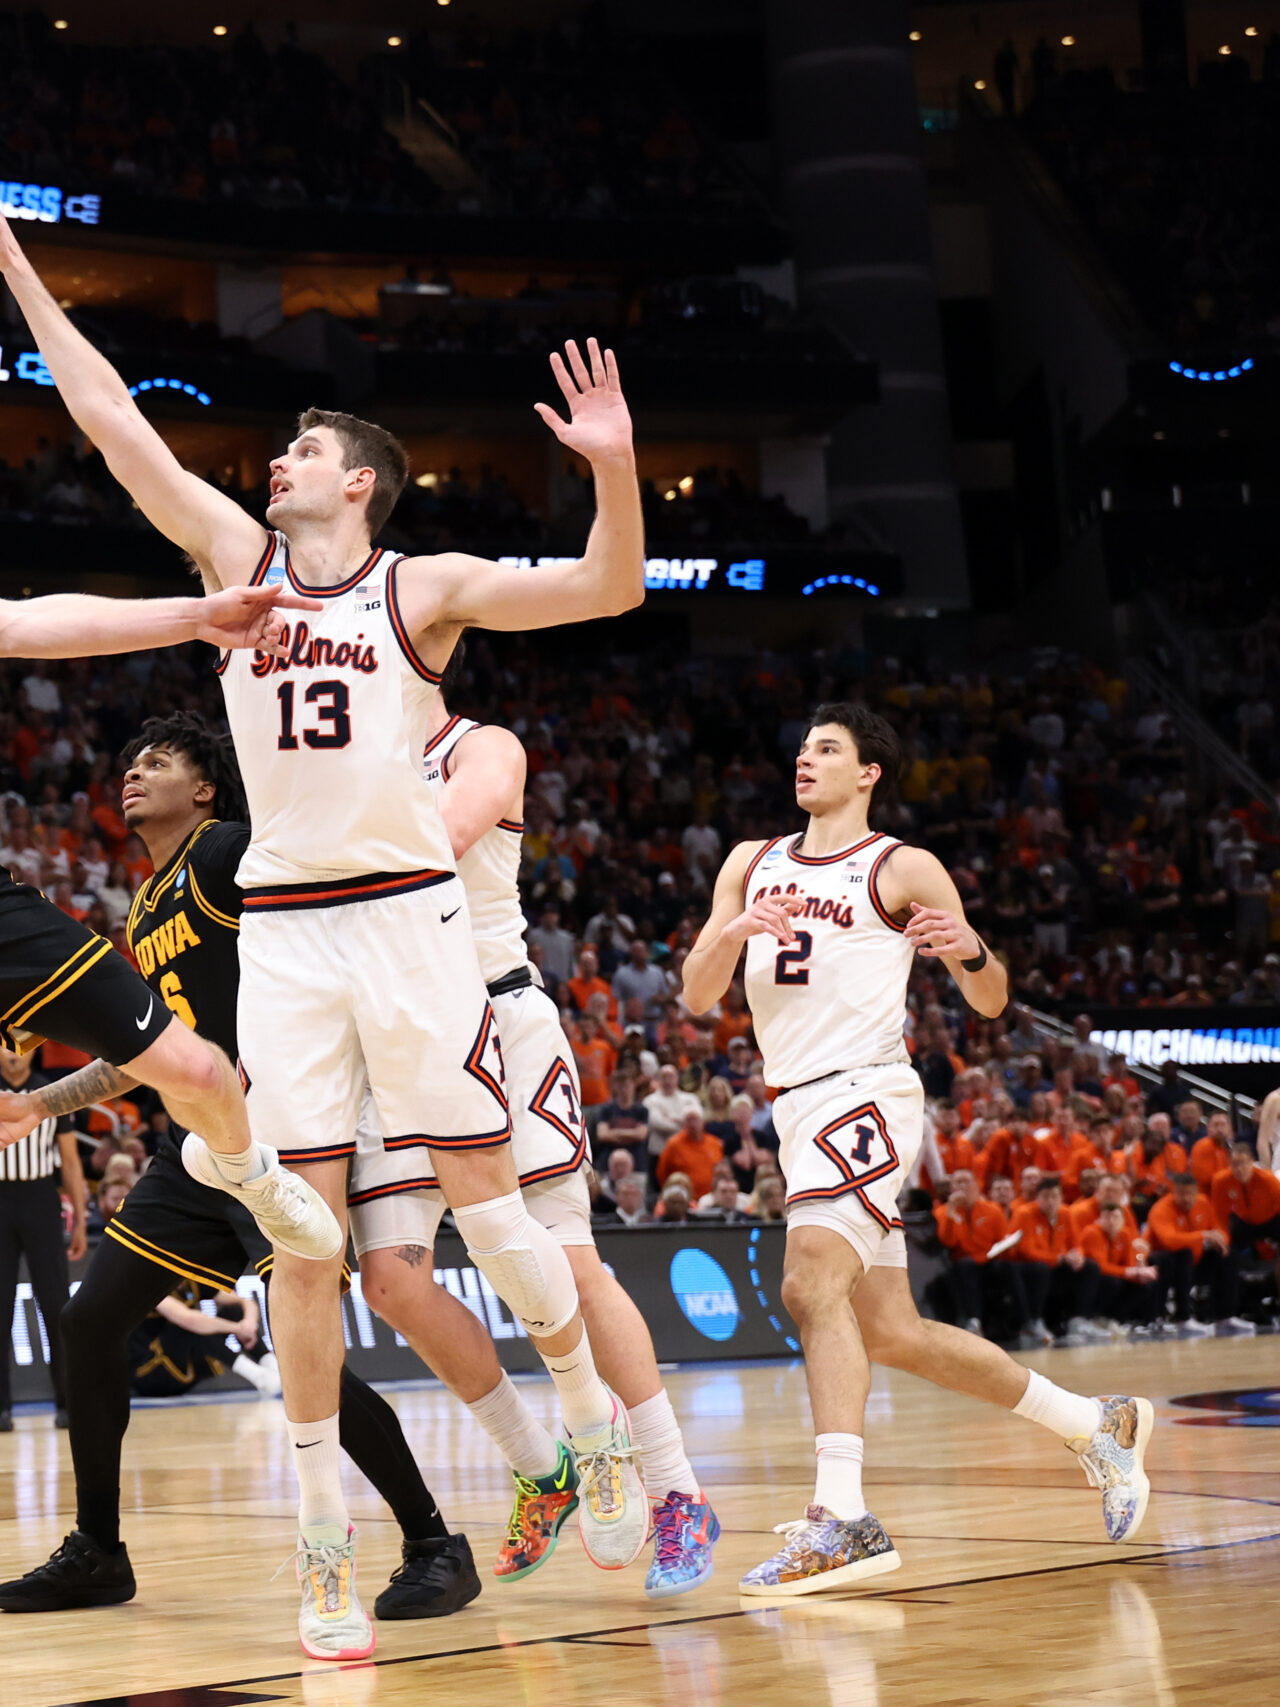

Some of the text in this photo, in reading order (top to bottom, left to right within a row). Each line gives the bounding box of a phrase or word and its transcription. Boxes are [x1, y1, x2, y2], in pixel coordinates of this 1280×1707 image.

[277, 679, 352, 751] 13
[134, 911, 202, 980] IOWA
[775, 930, 812, 985] 2
[1088, 1028, 1280, 1066] MARCHMADN
